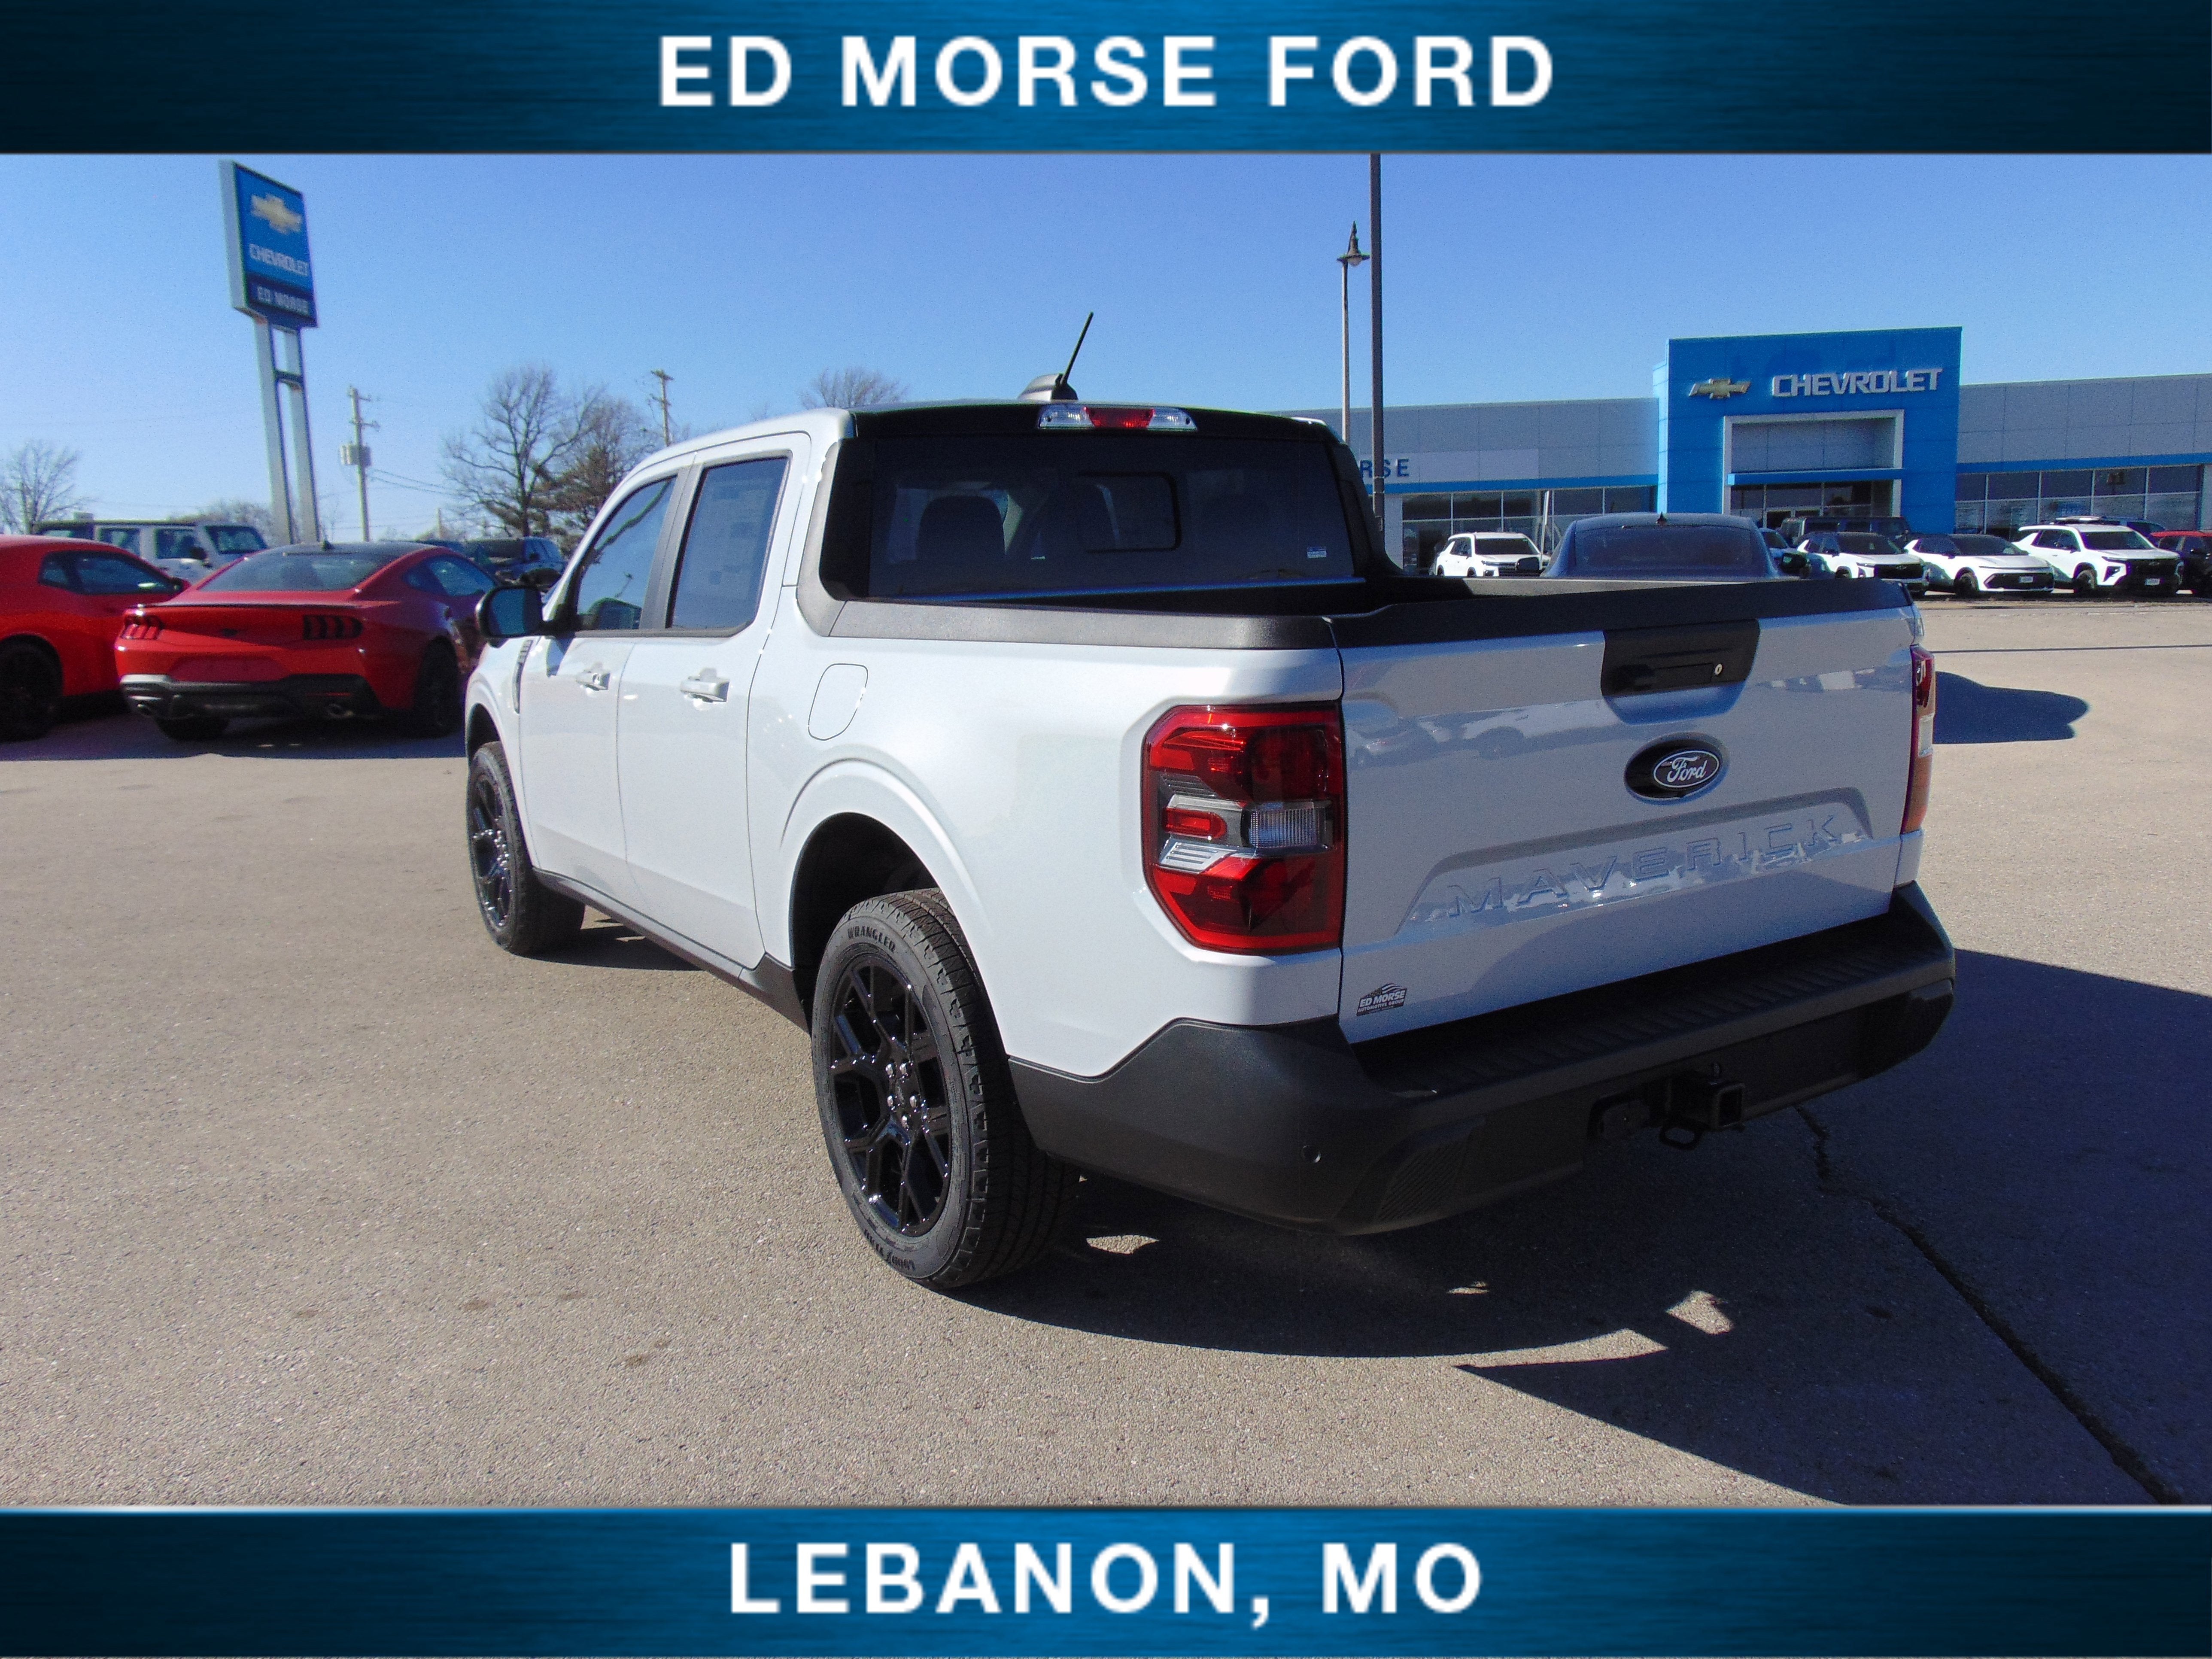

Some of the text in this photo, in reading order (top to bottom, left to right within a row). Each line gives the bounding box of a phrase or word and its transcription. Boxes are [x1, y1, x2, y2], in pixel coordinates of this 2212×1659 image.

[249, 243, 309, 276] CHEVROLET
[1772, 368, 1943, 397] CHEVROLET
[1360, 458, 1409, 478] RSE
[1667, 756, 1708, 783] Ford
[1447, 815, 1838, 918] MAVERICK
[848, 925, 896, 953] WRANGLER
[1358, 1002, 1388, 1012] AUTOMOTIVE
[1360, 990, 1406, 1007] ED MORSE
